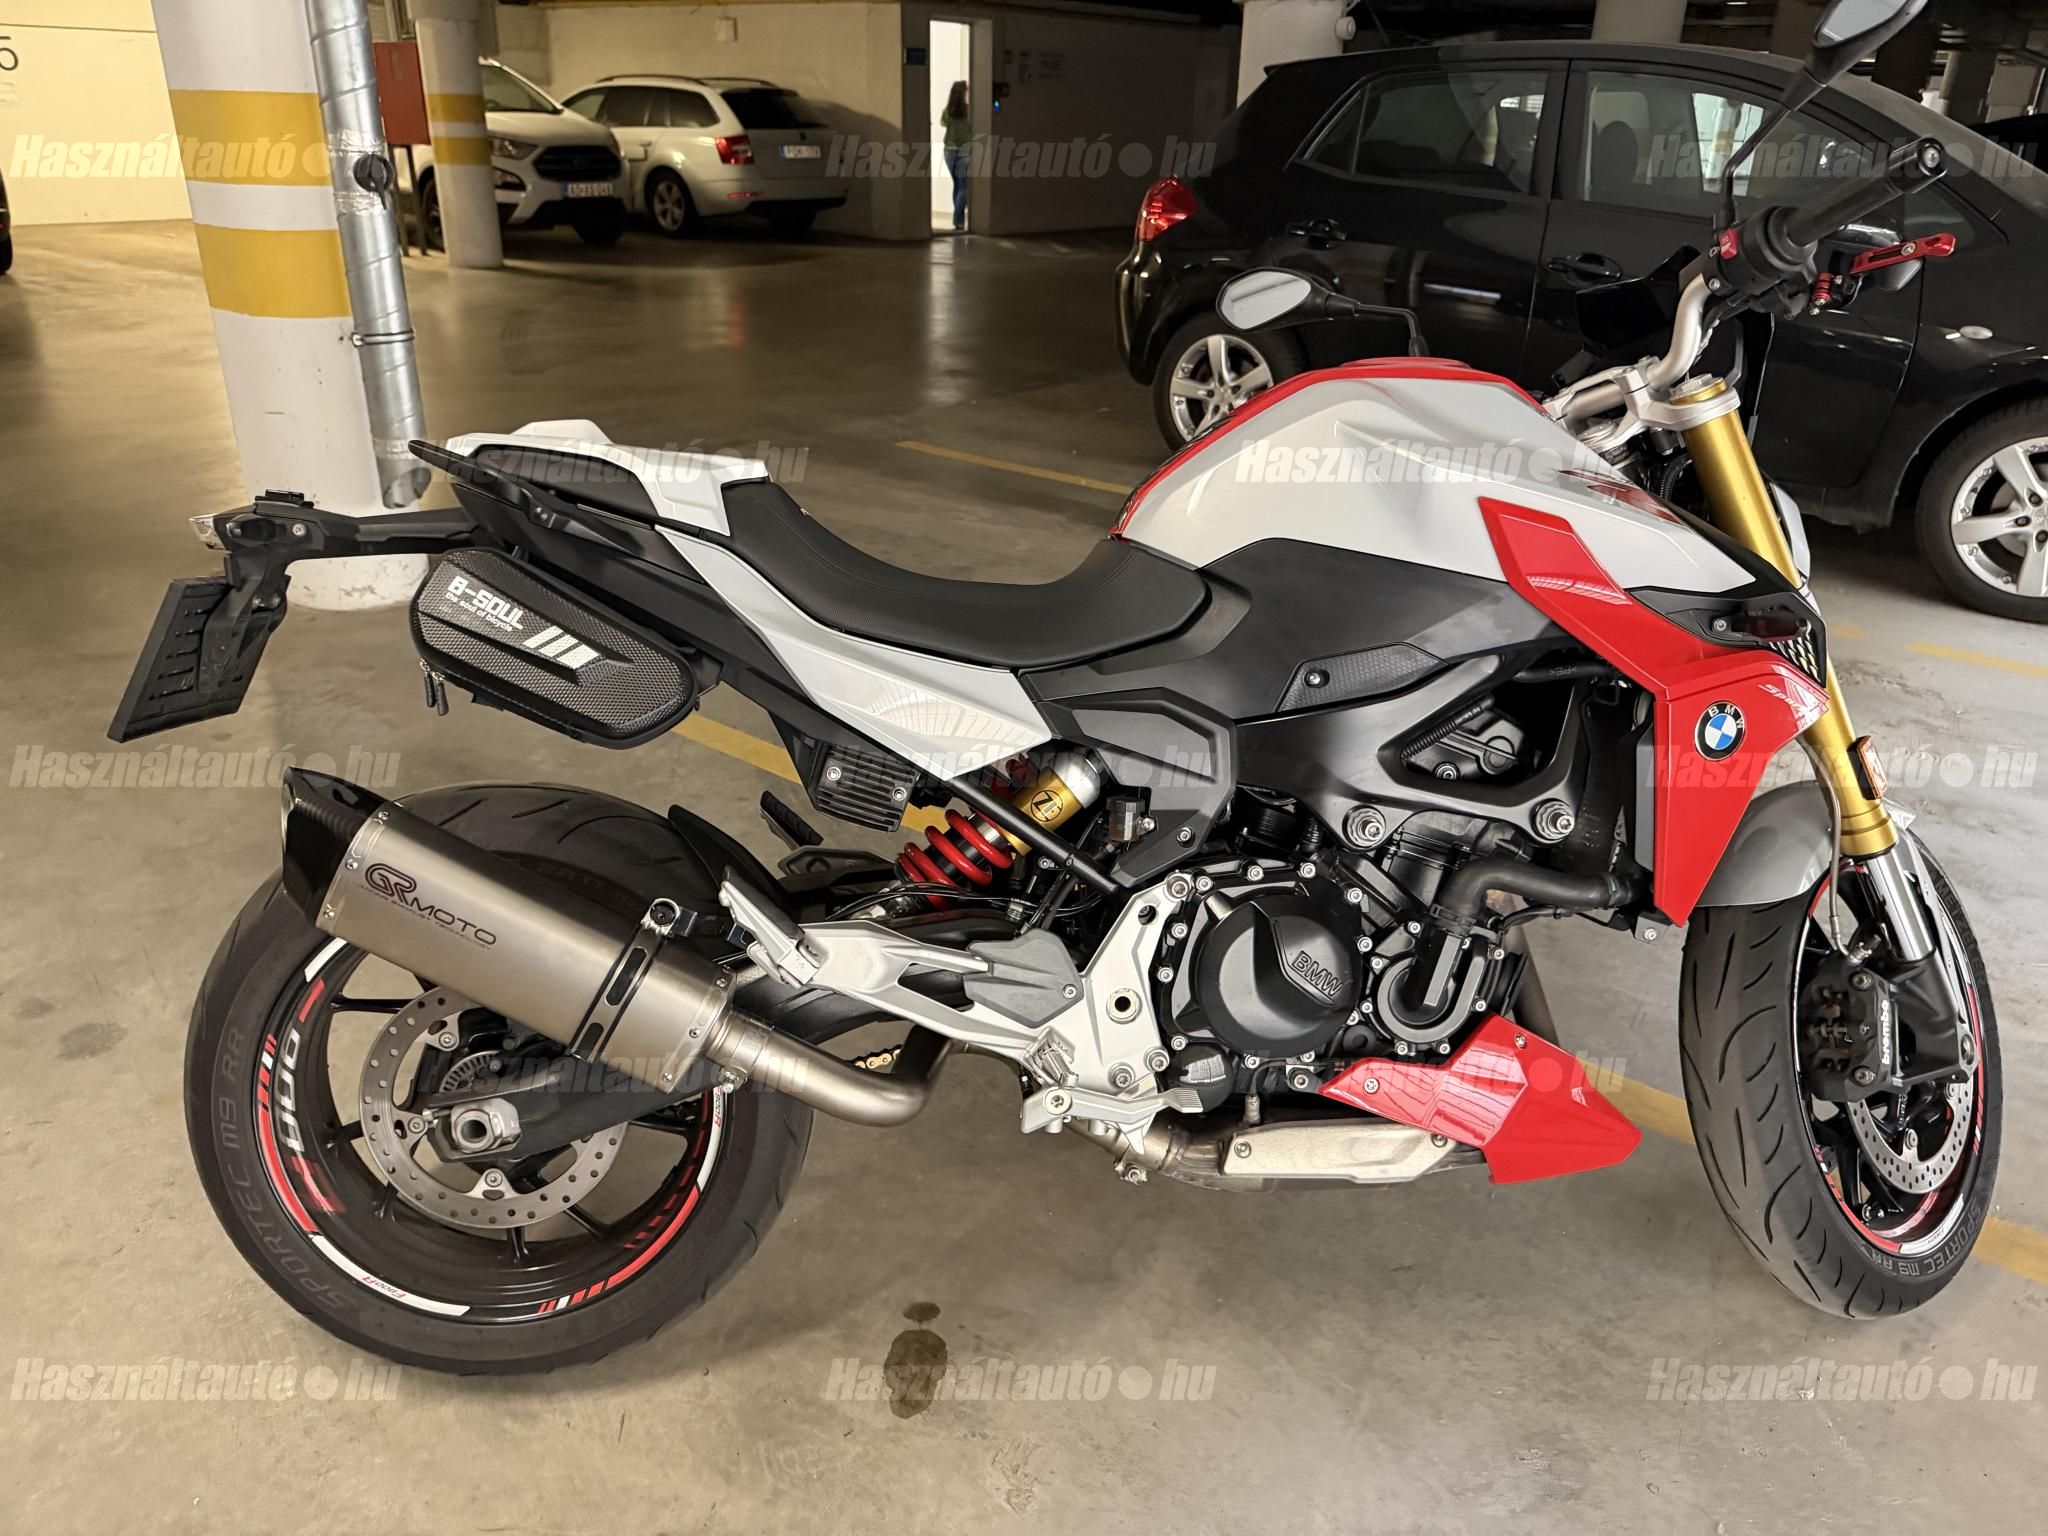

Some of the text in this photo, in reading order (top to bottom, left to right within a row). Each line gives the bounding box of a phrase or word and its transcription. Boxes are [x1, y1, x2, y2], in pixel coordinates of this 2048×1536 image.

[447, 576, 524, 630] B-SOUL
[485, 611, 513, 632] bicycle
[1708, 704, 1745, 729] BMW
[1291, 950, 1343, 997] BMW
[1881, 1000, 1891, 1064] brembo
[1926, 1196, 1981, 1274] SPORTEC
